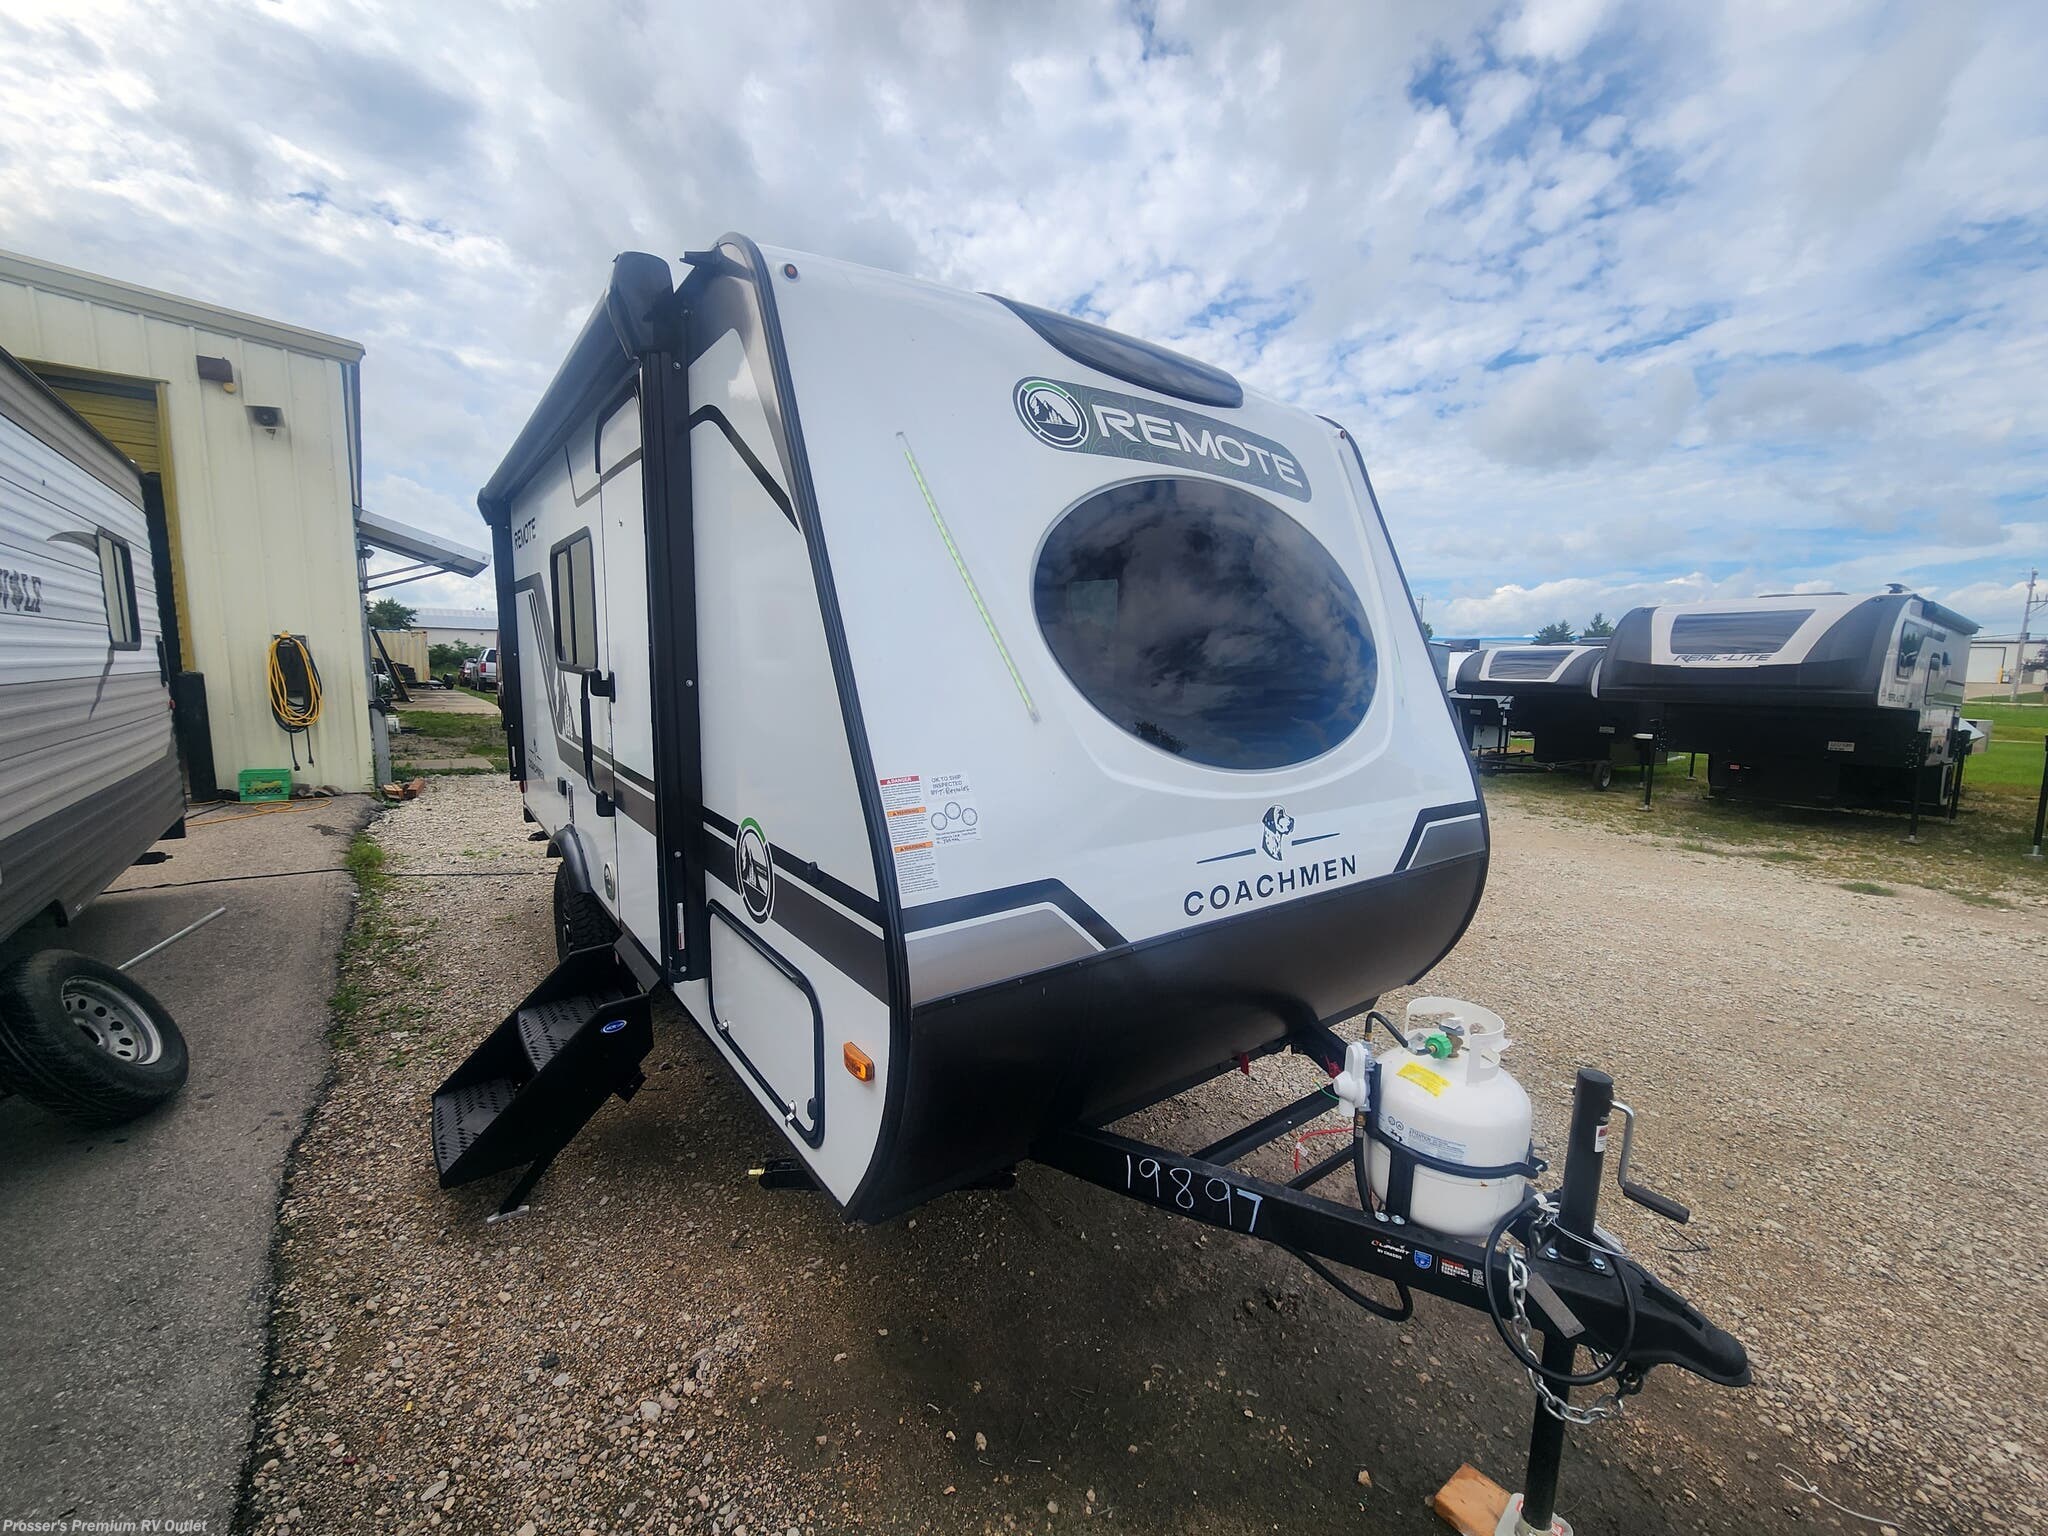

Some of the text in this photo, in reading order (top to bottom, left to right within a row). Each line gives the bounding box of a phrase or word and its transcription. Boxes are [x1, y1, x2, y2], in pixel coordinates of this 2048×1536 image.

[1091, 404, 1304, 488] REMOTE
[1674, 654, 1773, 663] REAL-LITE
[1183, 854, 1358, 918] COACHMEN
[1126, 1154, 1263, 1233] 19897
